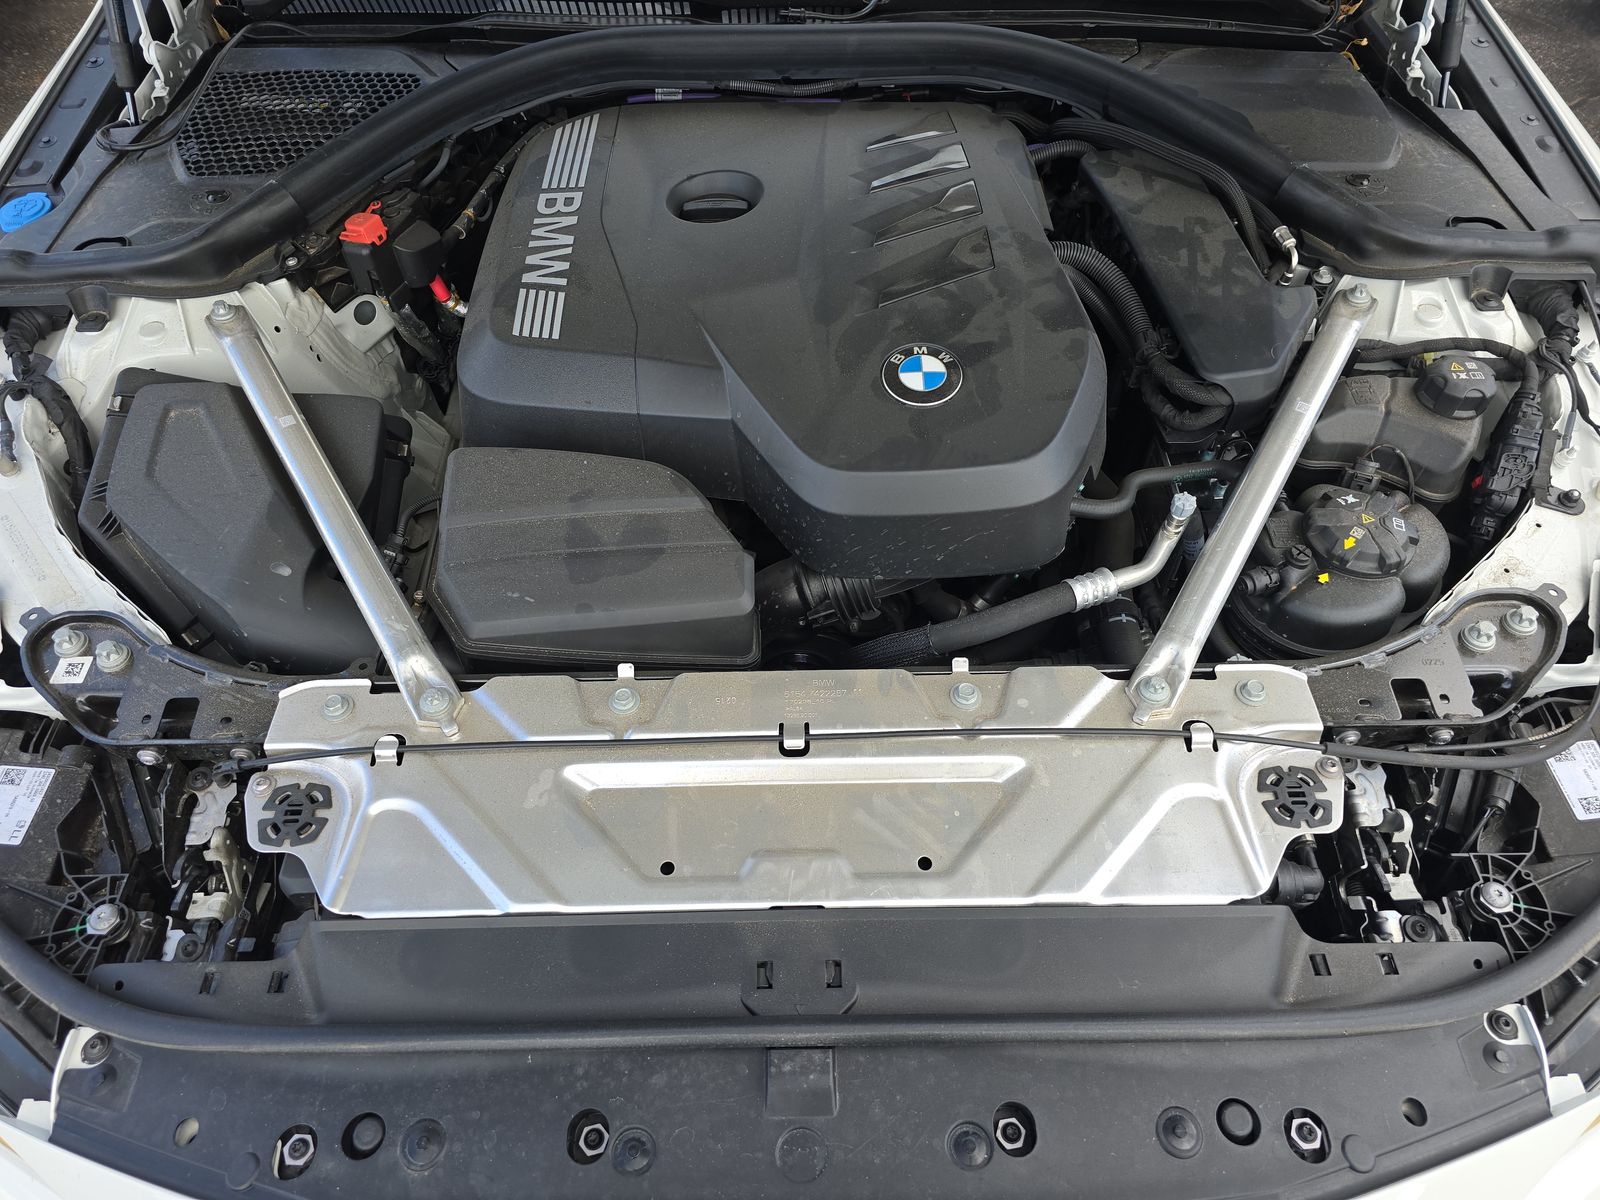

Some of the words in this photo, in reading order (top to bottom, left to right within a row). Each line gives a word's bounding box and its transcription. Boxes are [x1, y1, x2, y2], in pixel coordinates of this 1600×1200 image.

[521, 191, 583, 286] BMW
[890, 346, 954, 365] BMW
[812, 679, 835, 687] BMW
